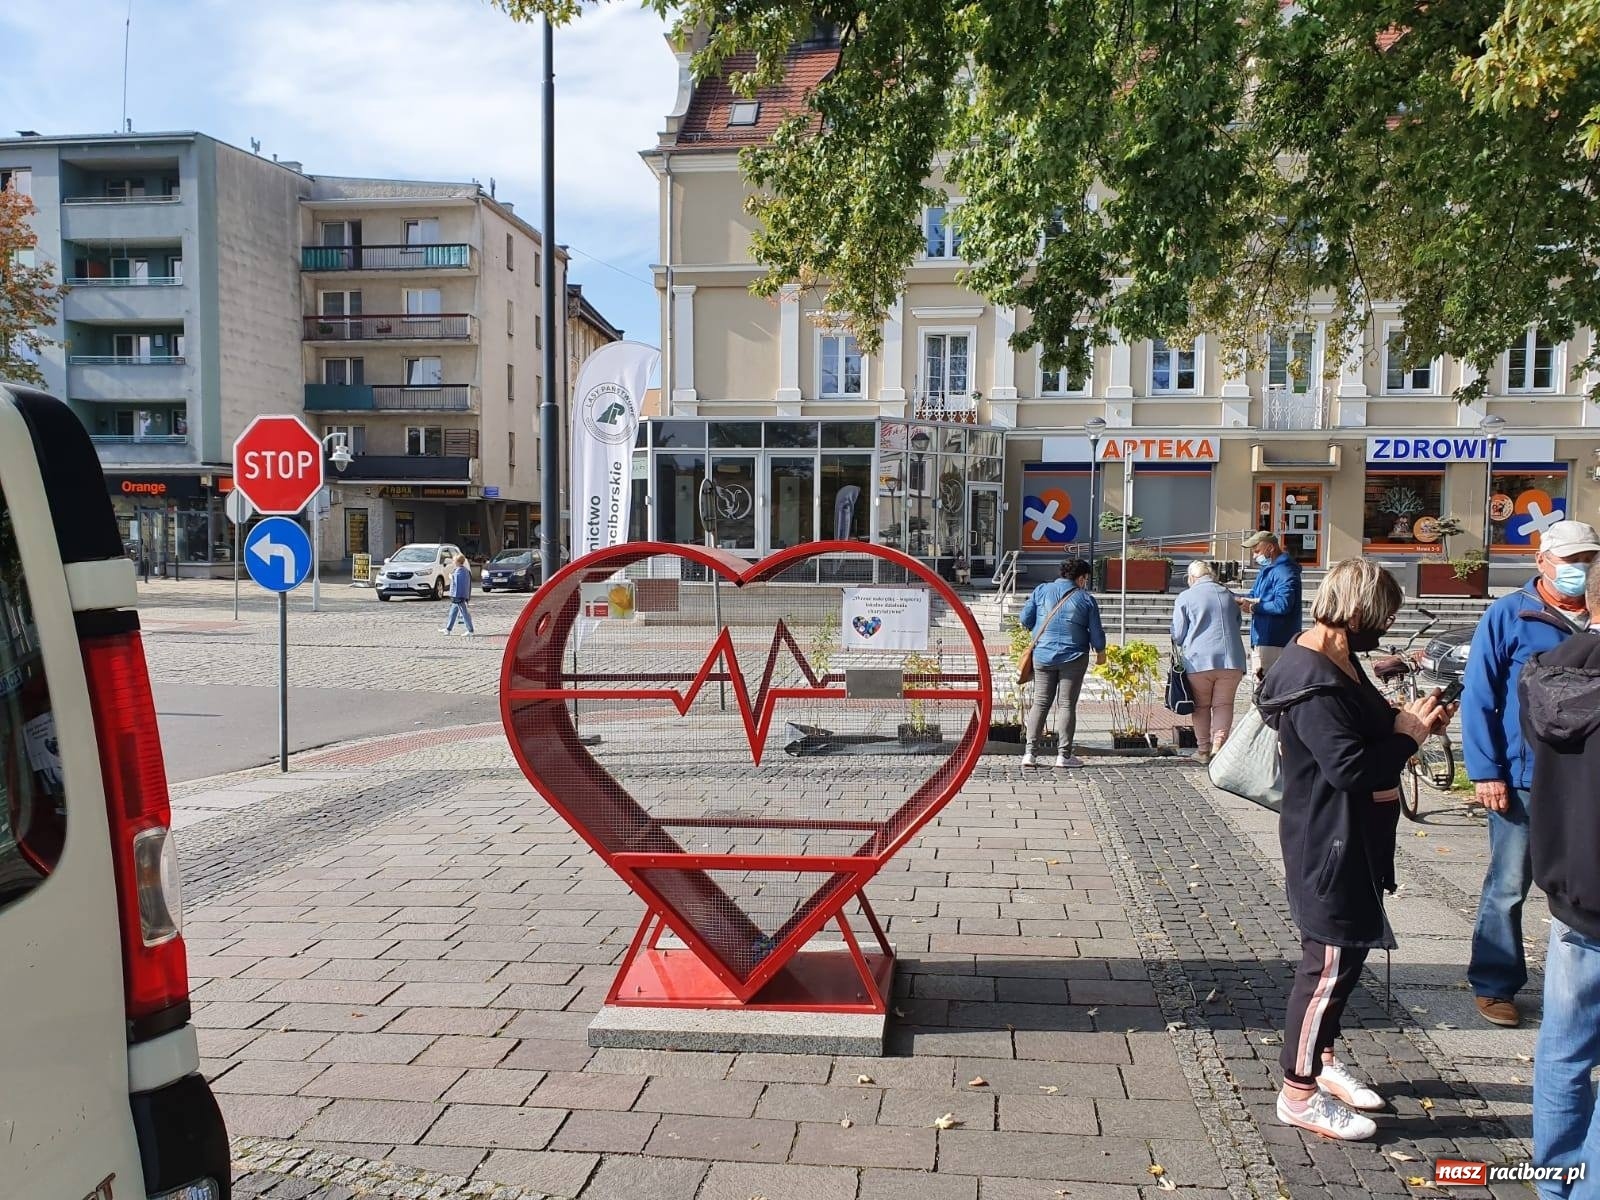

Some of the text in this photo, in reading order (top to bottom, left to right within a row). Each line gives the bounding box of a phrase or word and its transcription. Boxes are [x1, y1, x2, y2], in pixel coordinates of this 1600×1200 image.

[585, 389, 600, 408] LASY
[1102, 439, 1214, 458] APTEKA
[1373, 439, 1507, 459] ZDROWIT
[244, 451, 313, 479] STOP
[121, 481, 166, 494] Orange
